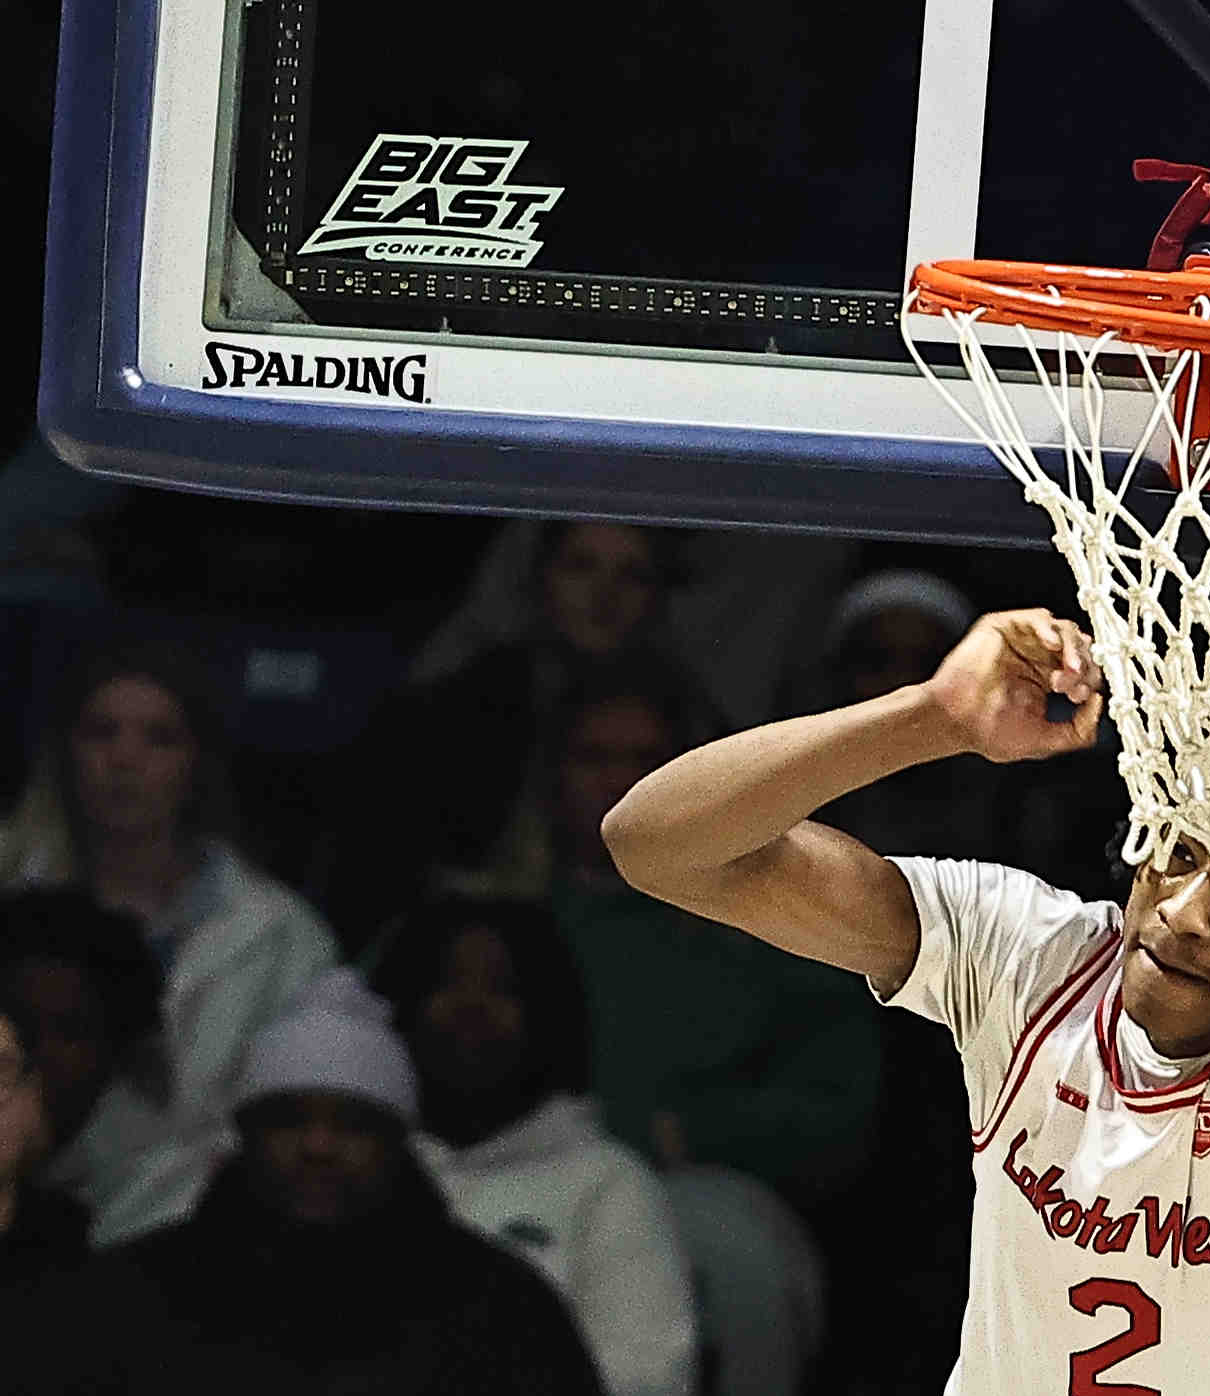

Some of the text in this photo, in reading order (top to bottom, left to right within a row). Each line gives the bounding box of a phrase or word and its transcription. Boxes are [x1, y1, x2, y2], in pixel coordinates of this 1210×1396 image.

[357, 139, 516, 186] BIG
[372, 242, 528, 261] CONFERENCE
[201, 340, 432, 404] SPALDING
